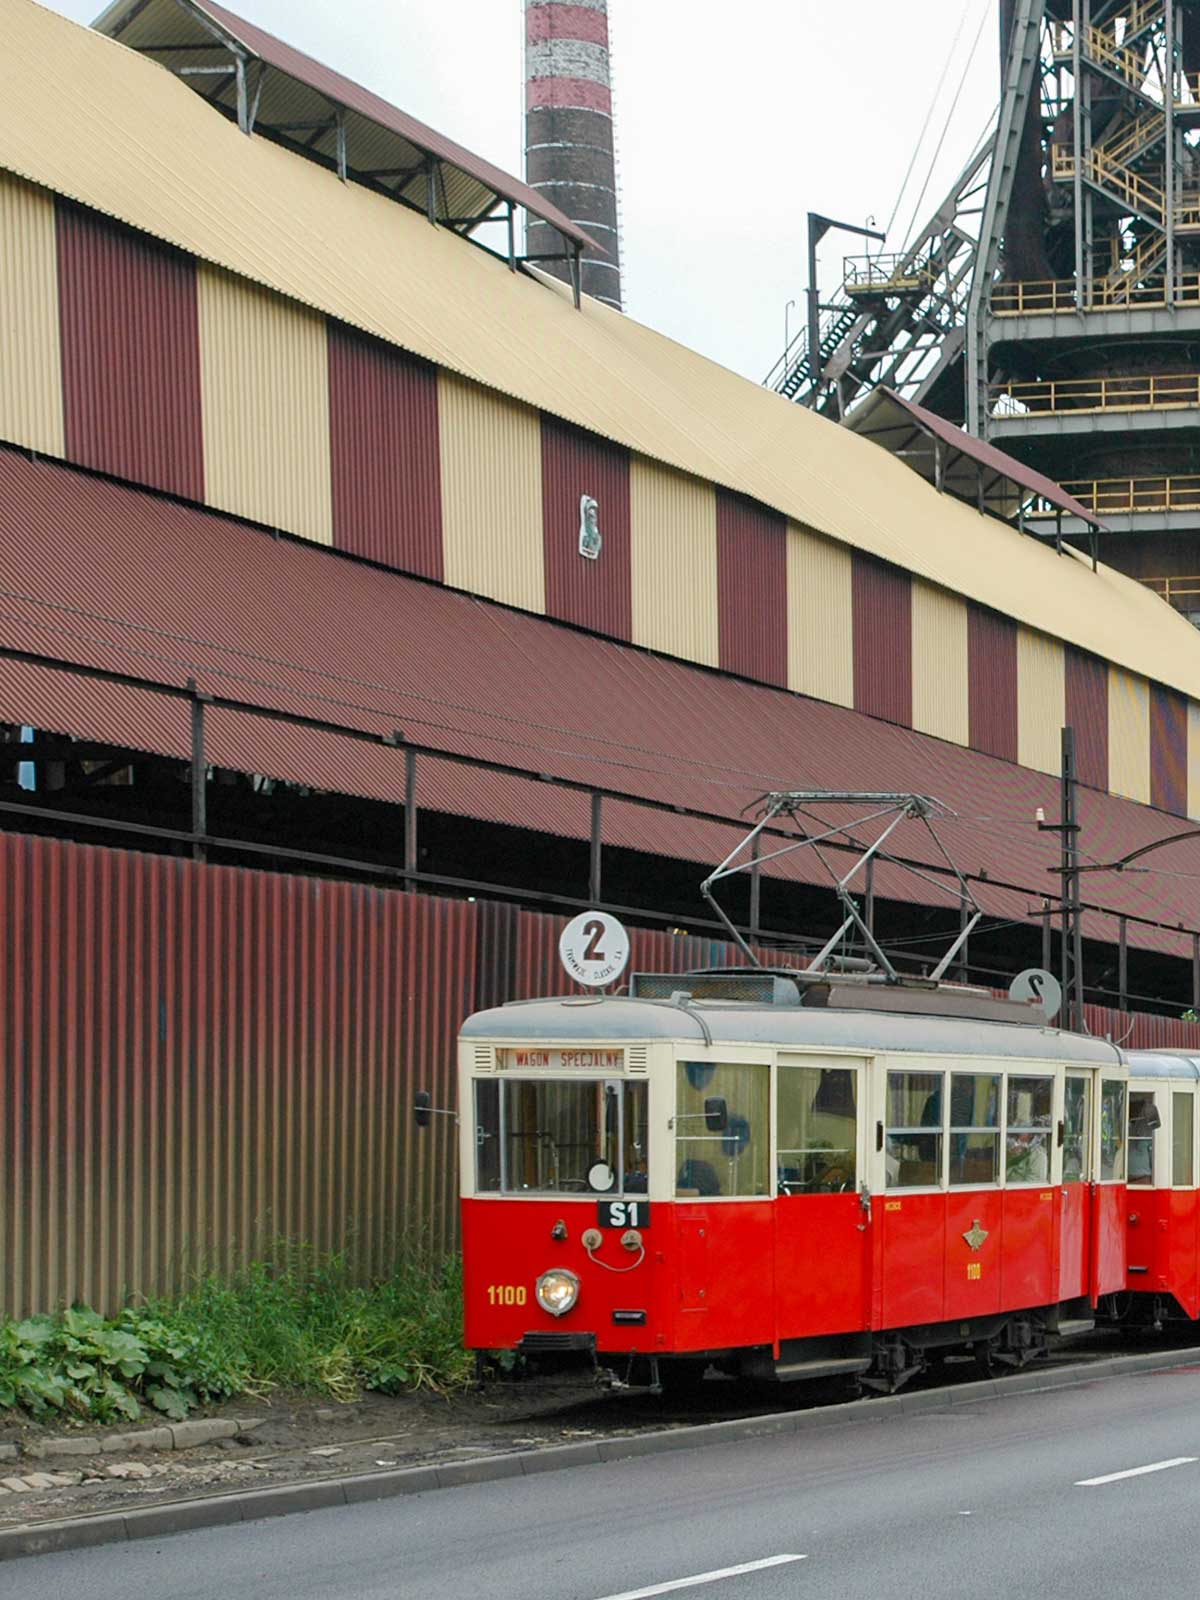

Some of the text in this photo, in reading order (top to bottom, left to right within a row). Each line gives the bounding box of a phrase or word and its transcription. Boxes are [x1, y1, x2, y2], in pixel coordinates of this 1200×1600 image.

[583, 920, 605, 960] 2
[515, 1052, 617, 1067] WAGON SPECJALNY
[609, 1202, 638, 1227] S1
[487, 1285, 527, 1306] 1100
